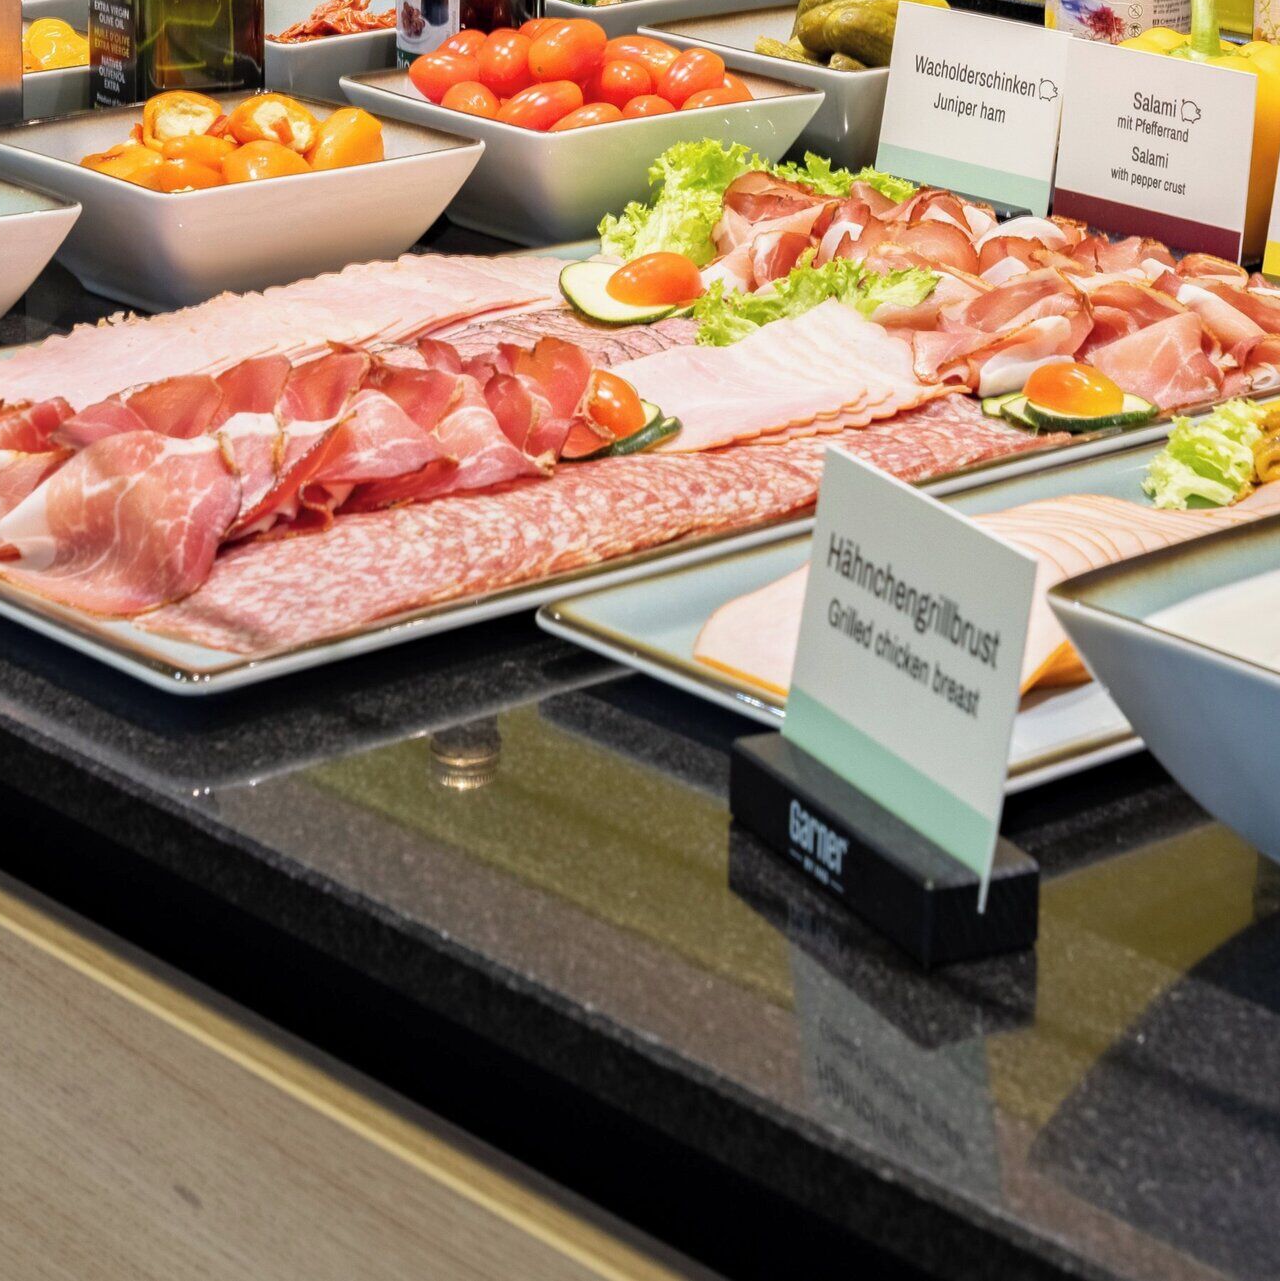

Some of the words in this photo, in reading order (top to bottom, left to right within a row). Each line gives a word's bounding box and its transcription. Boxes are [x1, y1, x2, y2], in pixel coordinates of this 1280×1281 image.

[94, 0, 110, 13] EXTRA
[111, 5, 130, 20] VIRGIN
[99, 12, 114, 26] OLIVE
[115, 18, 125, 30] OIL
[915, 54, 1036, 97] Wacholderschinken
[933, 92, 977, 118] Juniper
[980, 101, 1006, 123] ham
[1133, 91, 1177, 119] Salami
[1117, 114, 1133, 129] mit
[1135, 117, 1190, 143] Pfefferrand
[1131, 146, 1170, 169] Salami
[1110, 166, 1130, 182] with
[1131, 172, 1162, 192] pepper
[1163, 177, 1187, 196] crust
[826, 532, 1002, 670] Hähnchengrillbrust
[827, 598, 874, 651] Grilled
[874, 631, 929, 685] chicken
[931, 660, 981, 720] breast
